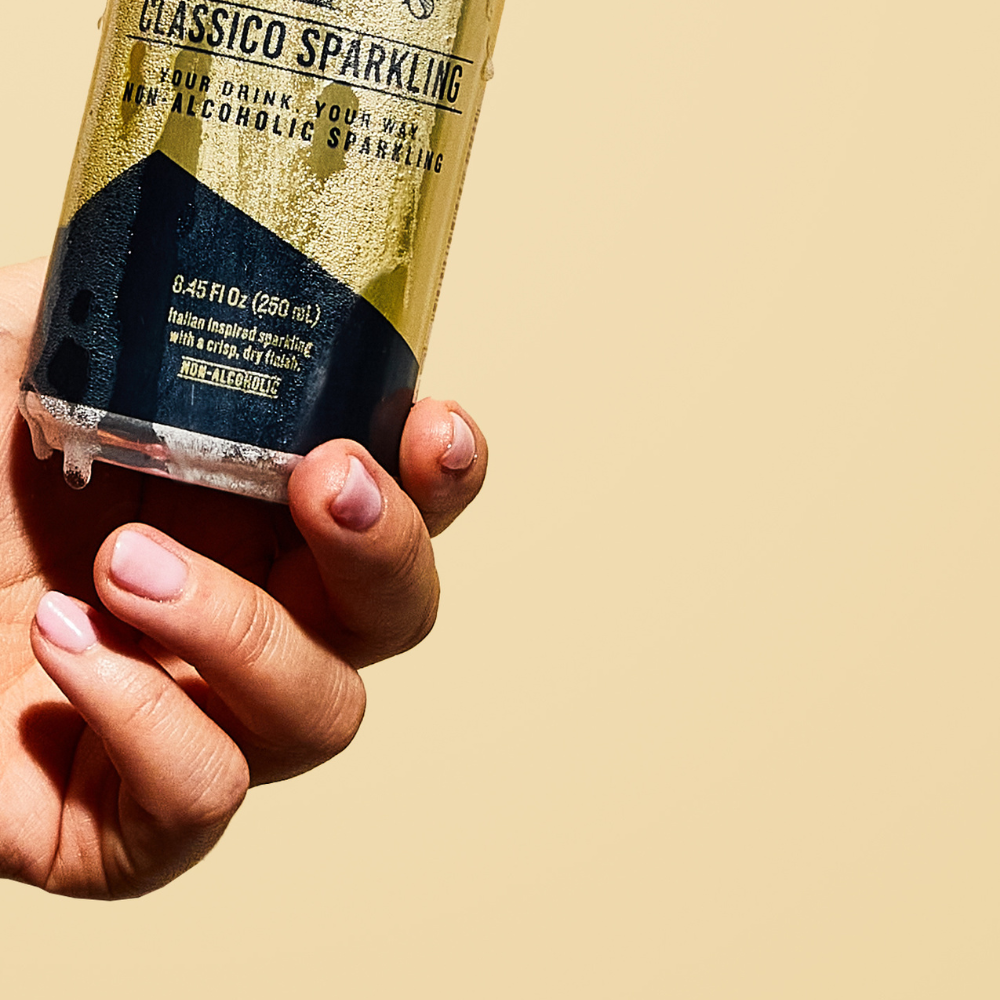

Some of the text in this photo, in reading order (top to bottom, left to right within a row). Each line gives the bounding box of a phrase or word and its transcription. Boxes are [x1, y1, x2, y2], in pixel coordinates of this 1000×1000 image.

[296, 26, 463, 104] SPARKLING
[159, 66, 211, 93] YOUR
[314, 99, 371, 130] YOUR
[122, 81, 444, 174] NON-ALCOHOLIC SPARKLING
[209, 281, 225, 304] Fl
[227, 286, 248, 309] Oz
[251, 290, 290, 319] (250
[167, 306, 205, 330] Italian
[258, 330, 314, 358] sparkling
[169, 330, 301, 372] with a crisp, dry finish.
[179, 360, 281, 395] NON-ALCOHOLIC
